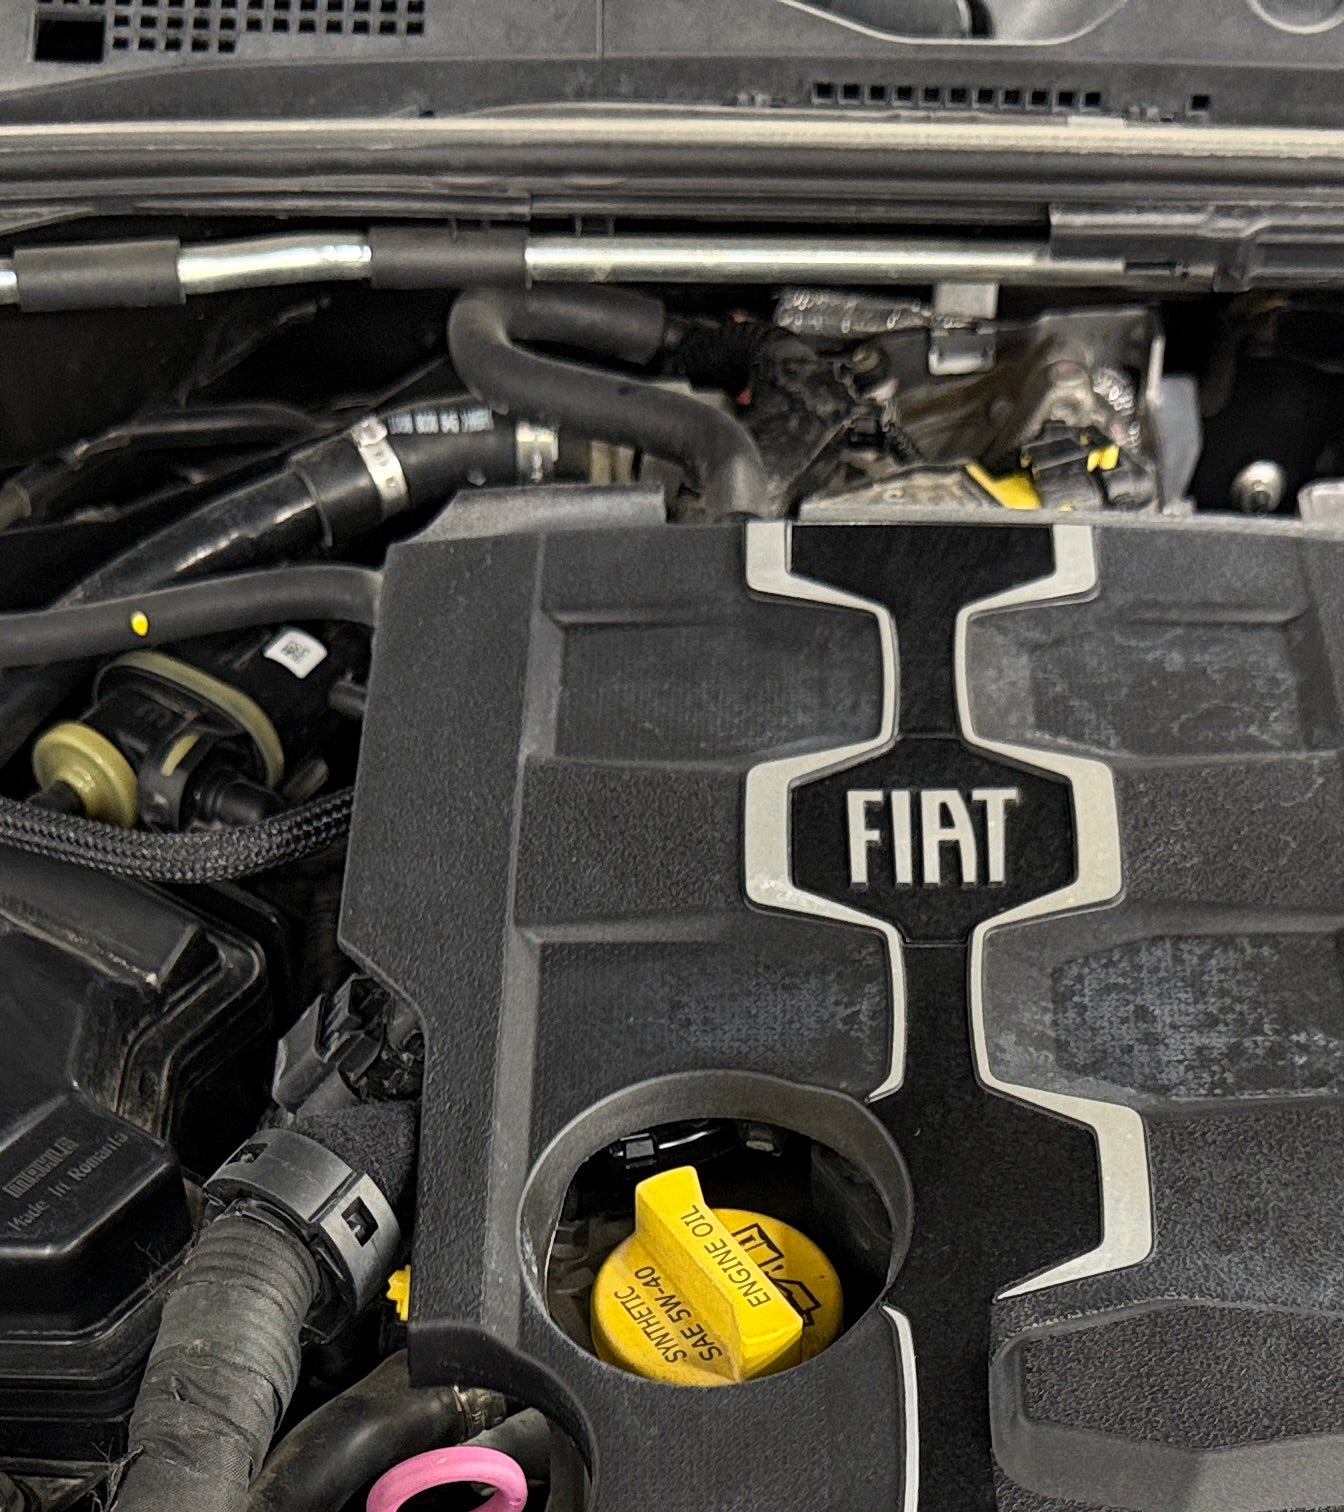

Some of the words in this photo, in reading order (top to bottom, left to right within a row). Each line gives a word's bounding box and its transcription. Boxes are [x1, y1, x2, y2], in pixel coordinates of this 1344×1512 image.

[845, 787, 1018, 886] FIAT
[680, 1204, 714, 1238] OIL
[634, 1265, 692, 1323] 5W-40
[703, 1238, 772, 1308] ENGINE
[613, 1285, 688, 1364] SYNTHETIC
[680, 1322, 723, 1362] SAE
